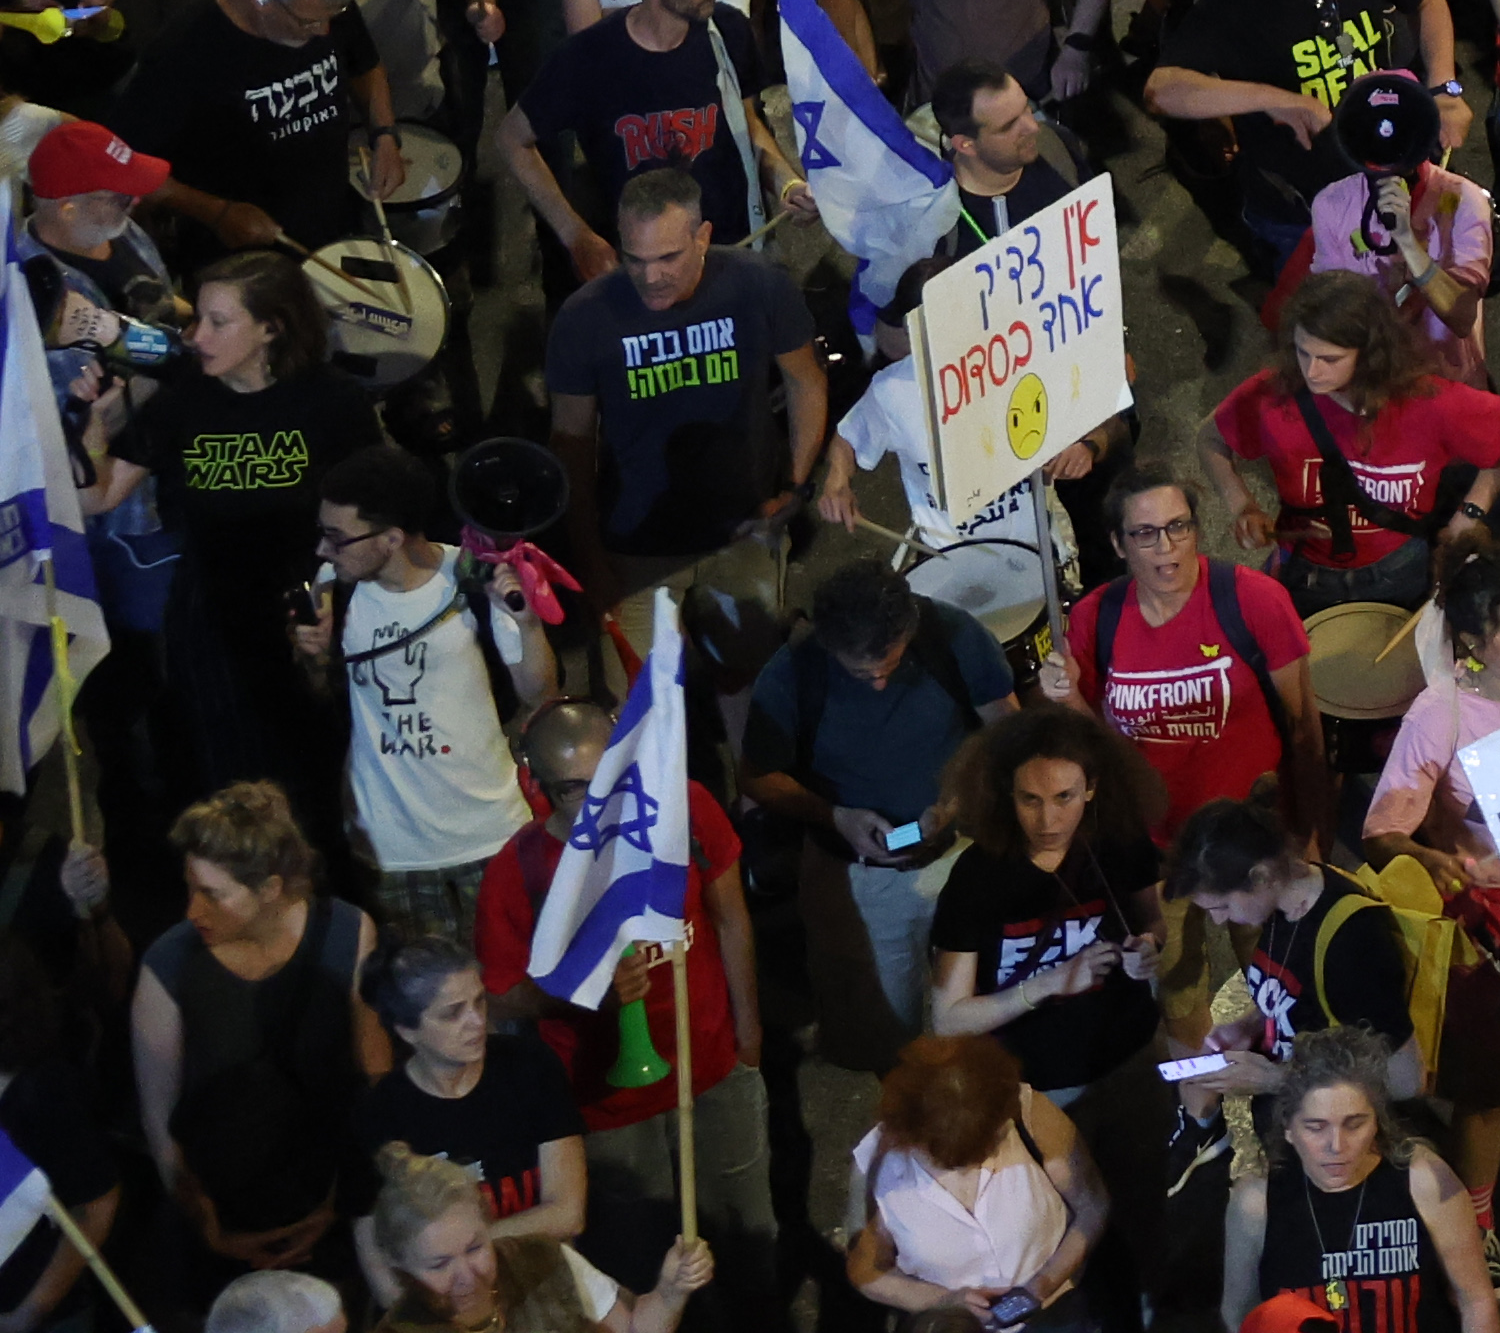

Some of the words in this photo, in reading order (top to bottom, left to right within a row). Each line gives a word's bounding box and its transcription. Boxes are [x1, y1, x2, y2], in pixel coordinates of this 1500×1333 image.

[1063, 199, 1100, 270] אין
[621, 328, 679, 367] בבית
[682, 317, 736, 353] אתם
[707, 348, 740, 381] הם
[184, 429, 309, 465] STAM
[184, 456, 309, 491] WARS
[1107, 675, 1214, 712] PINKFRONT
[1355, 1219, 1419, 1247] מחזירים
[1321, 1250, 1377, 1279] הביתה
[1378, 1244, 1420, 1273] אותם
